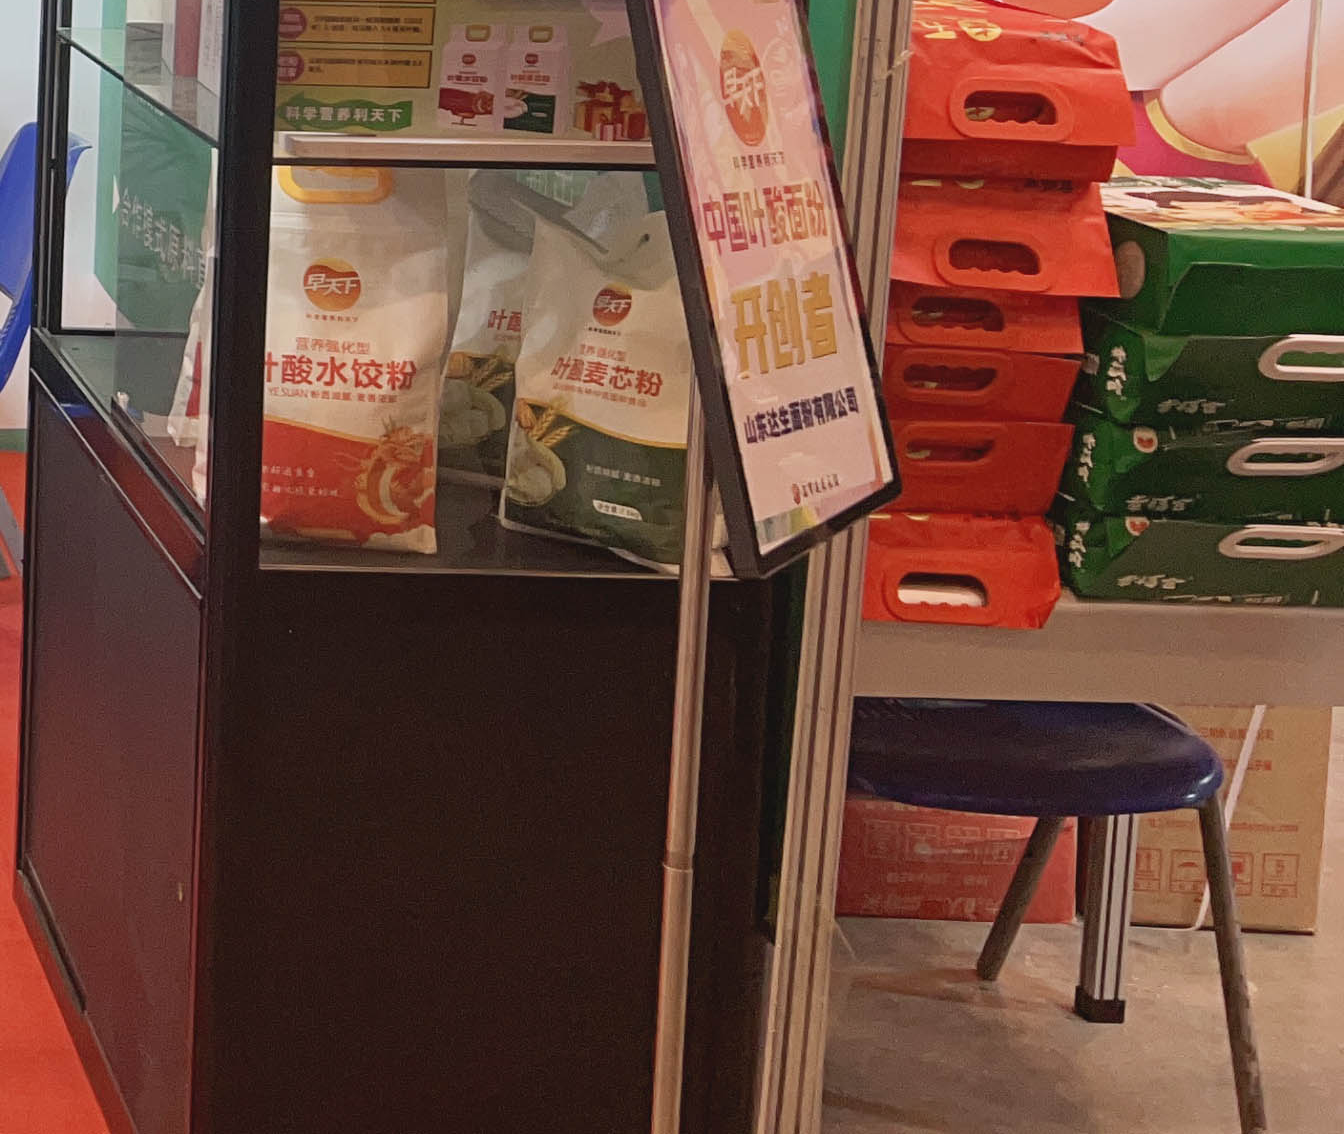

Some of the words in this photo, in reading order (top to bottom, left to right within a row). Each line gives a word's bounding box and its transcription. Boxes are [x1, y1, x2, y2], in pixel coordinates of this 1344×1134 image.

[703, 177, 827, 257] 中国叶酸面粉
[730, 273, 838, 380] 开创者
